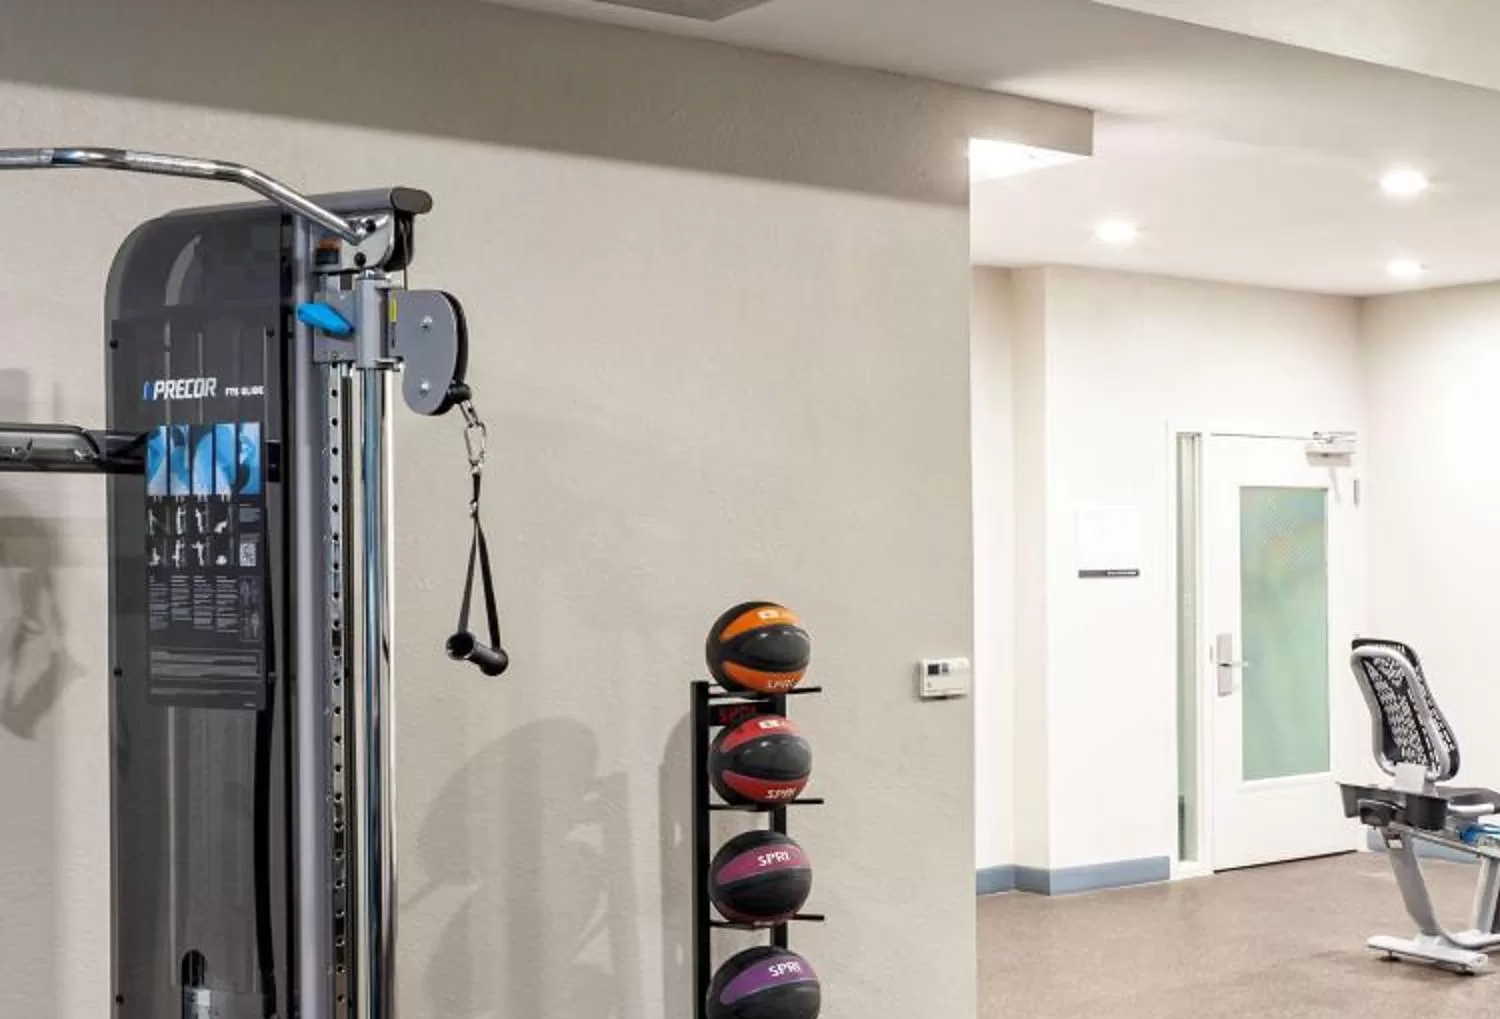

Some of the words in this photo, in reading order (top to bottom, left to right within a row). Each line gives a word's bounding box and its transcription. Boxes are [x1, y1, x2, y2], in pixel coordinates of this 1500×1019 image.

[154, 377, 217, 401] PRECOR
[757, 851, 790, 867] SPRI
[768, 961, 801, 977] SPRI
